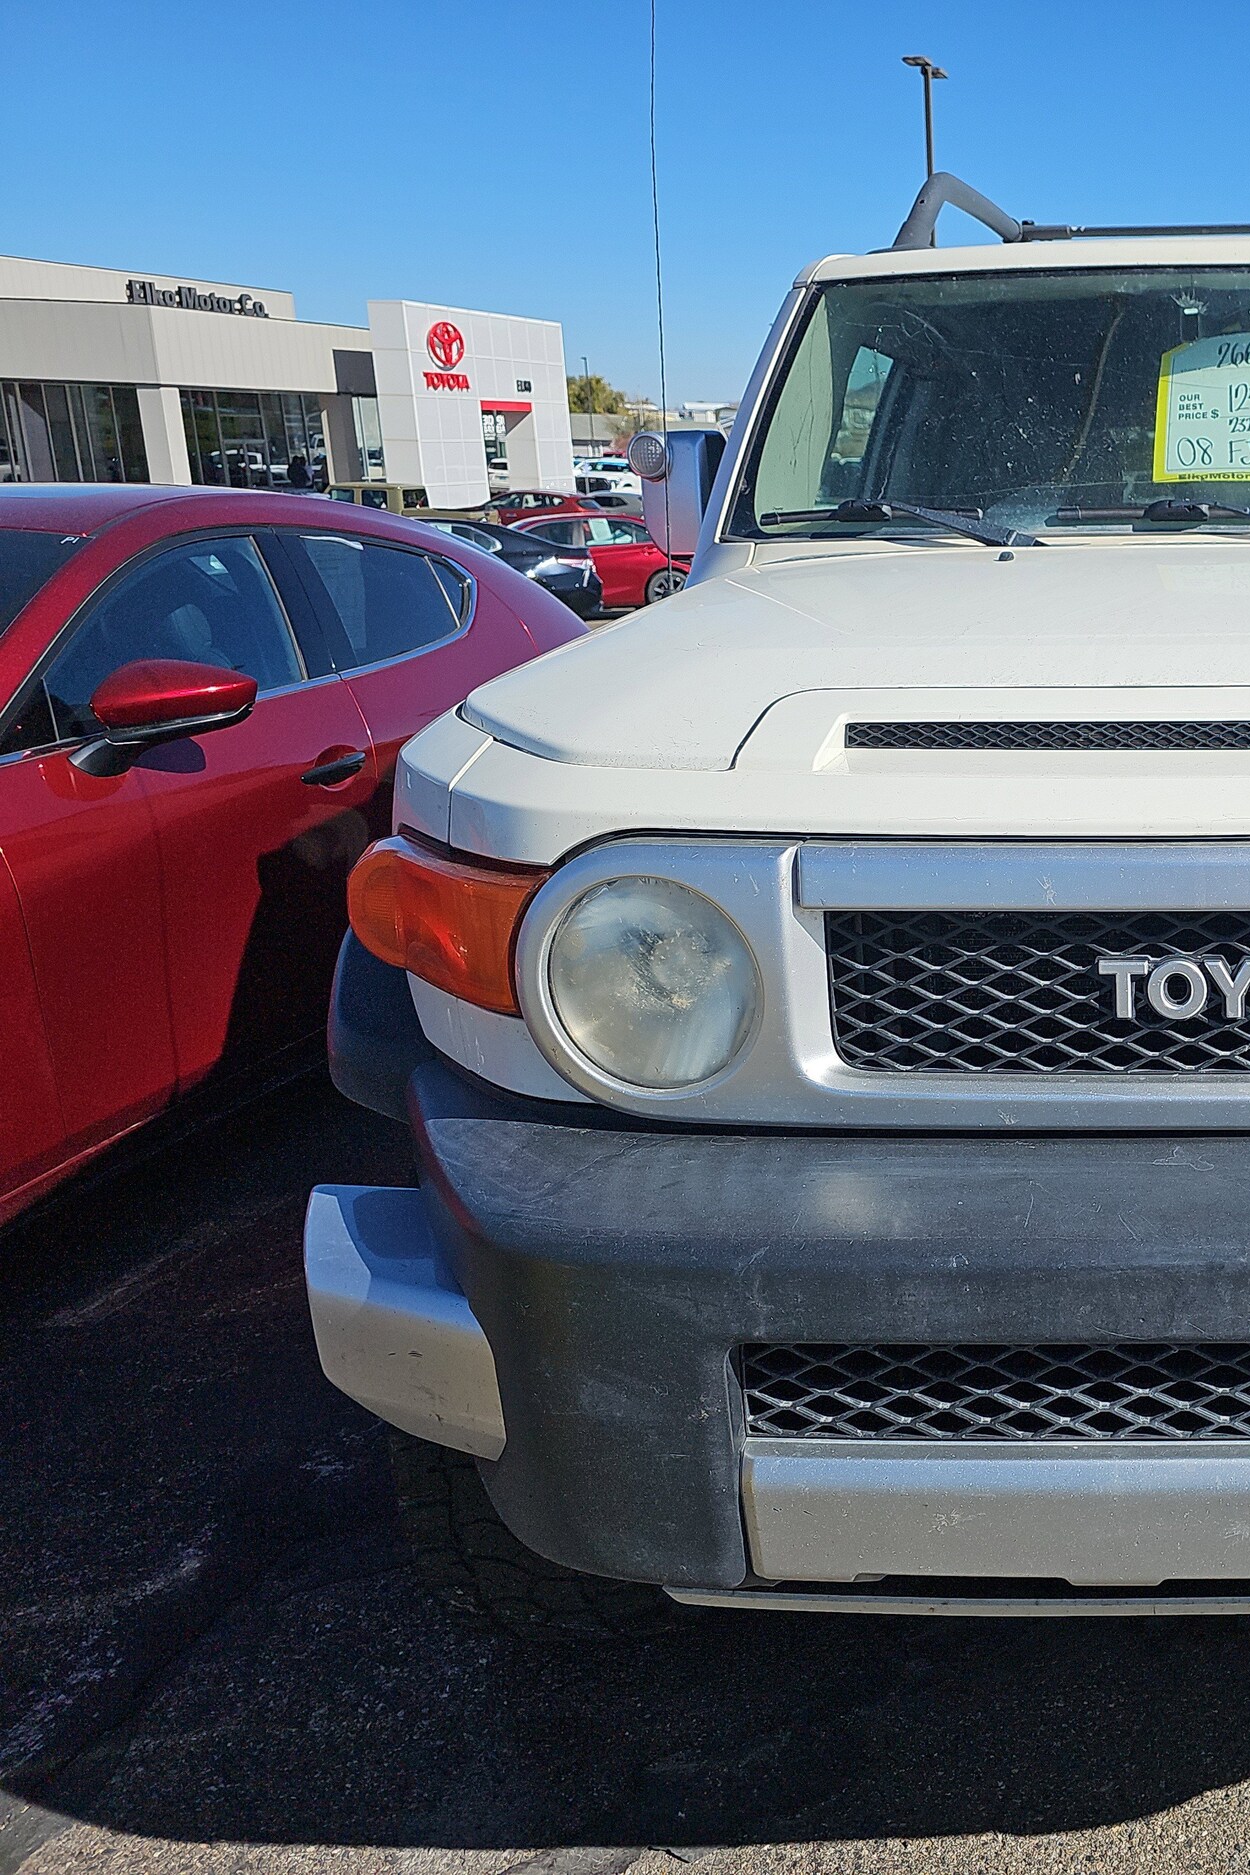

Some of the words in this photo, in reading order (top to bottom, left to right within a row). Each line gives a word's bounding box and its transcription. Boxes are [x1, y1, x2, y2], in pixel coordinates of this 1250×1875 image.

[126, 279, 176, 307] Elko
[176, 286, 238, 314] Motor
[238, 293, 269, 318] Co.
[422, 371, 471, 392] TOYOTA
[1179, 394, 1200, 402] OUR
[1178, 402, 1204, 411] BEST
[1178, 411, 1208, 420] PRICE
[1210, 408, 1219, 419] $
[1177, 437, 1213, 467] 08
